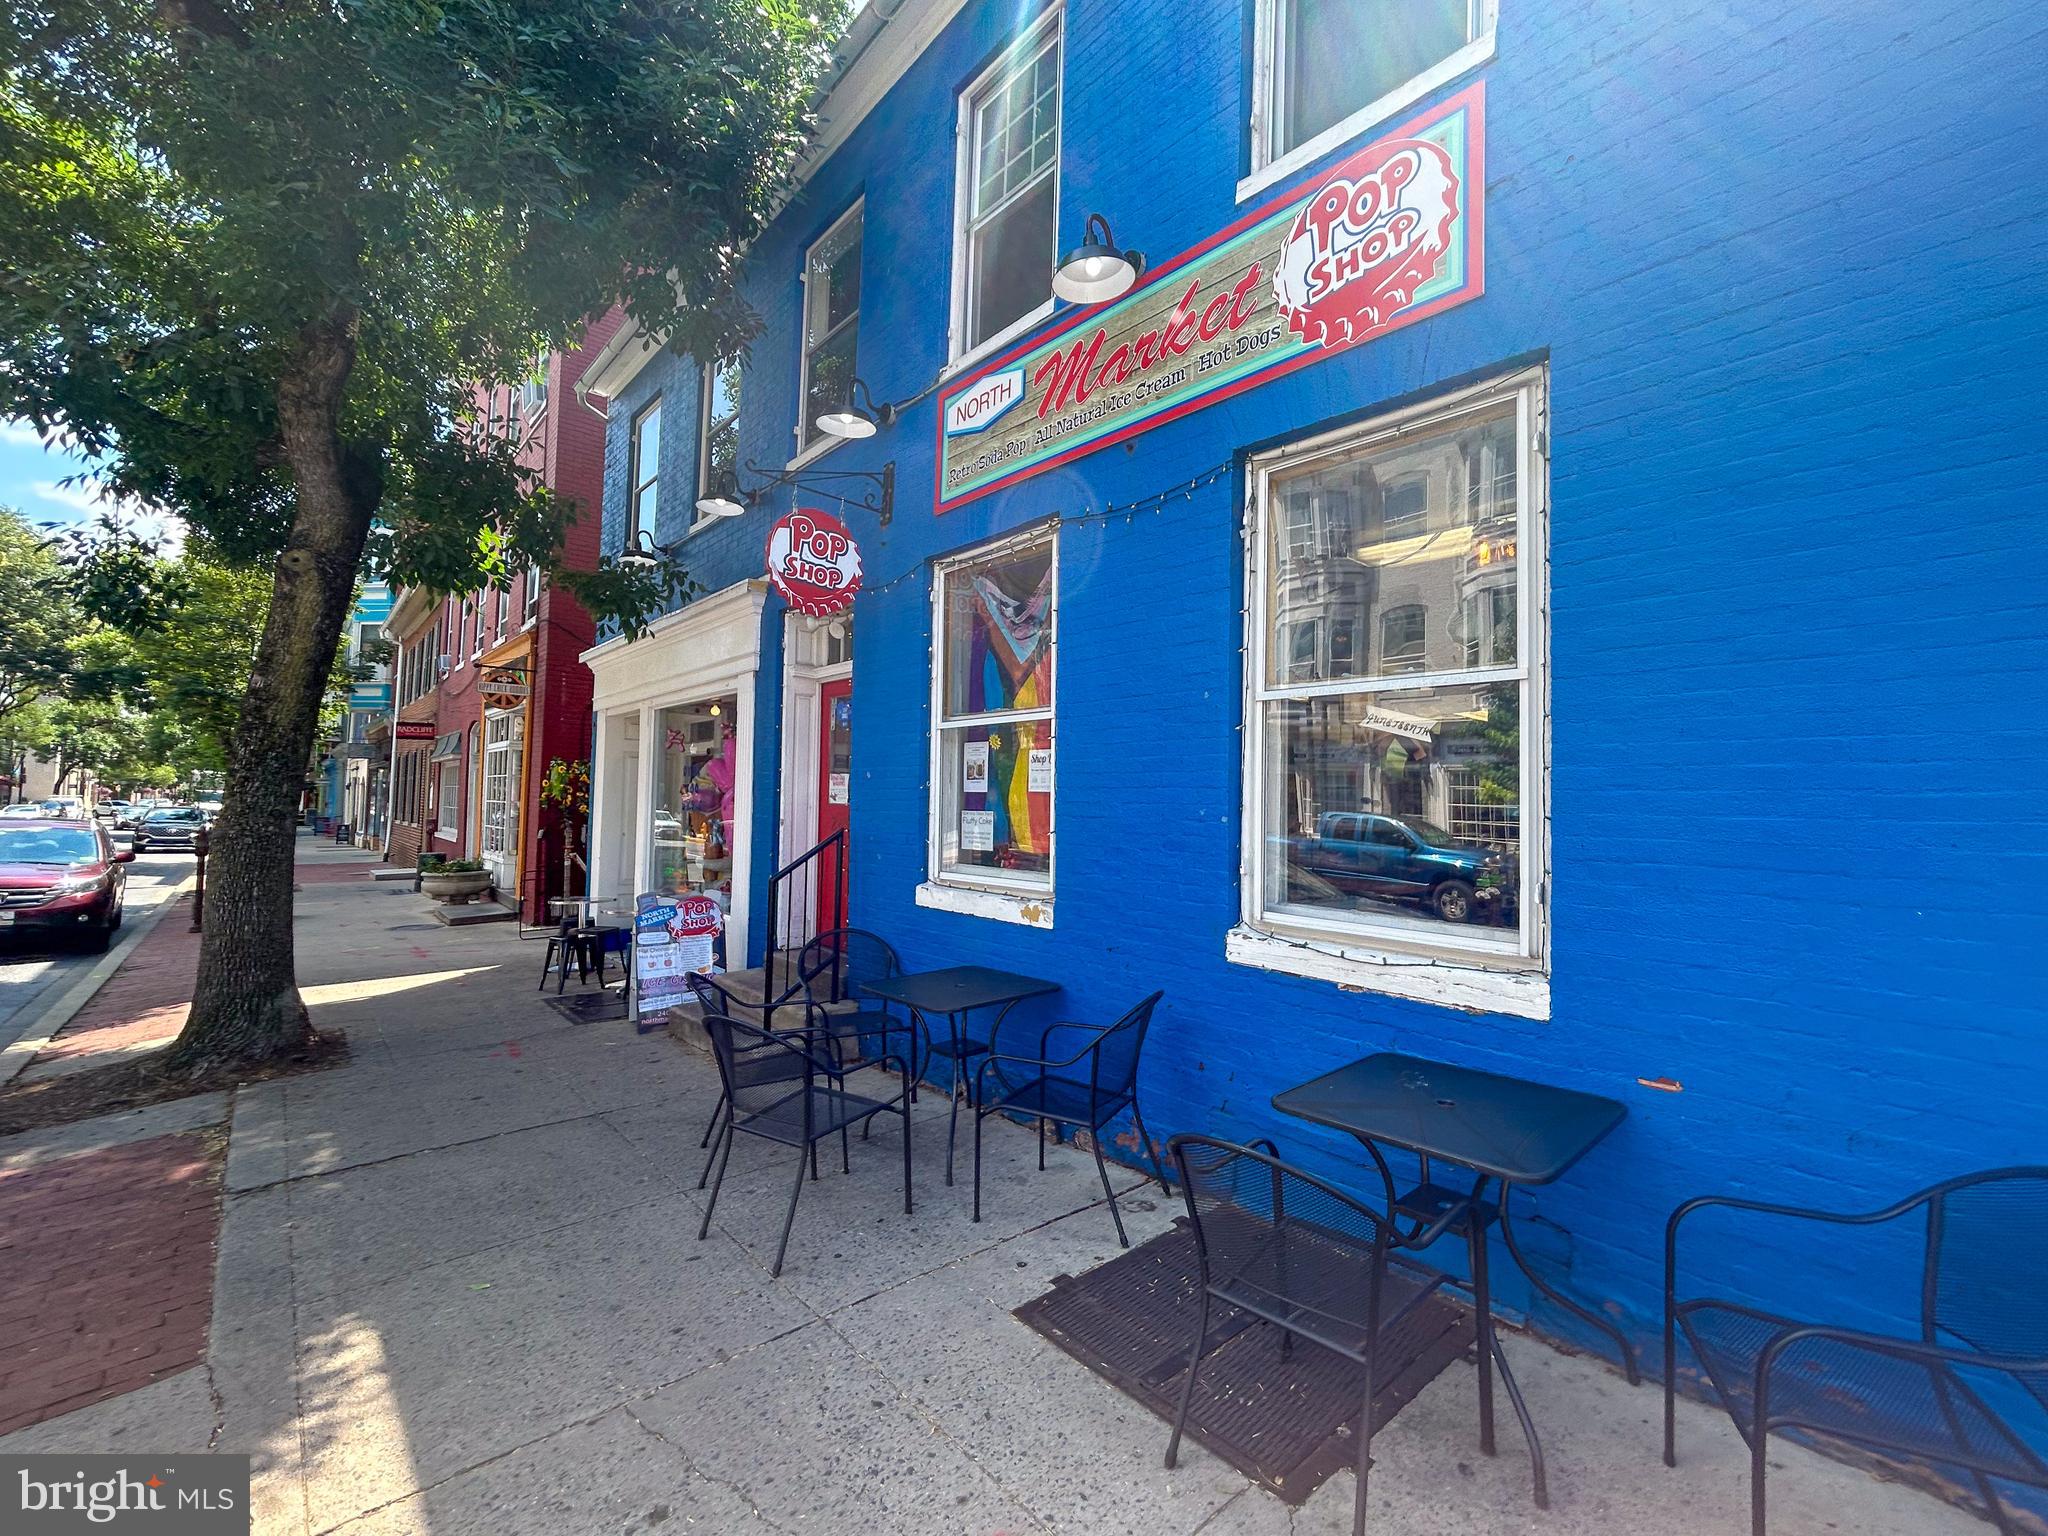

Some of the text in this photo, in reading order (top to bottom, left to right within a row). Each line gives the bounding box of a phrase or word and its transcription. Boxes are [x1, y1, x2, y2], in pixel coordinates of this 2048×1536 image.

[1308, 152, 1417, 255] POP
[1308, 211, 1417, 300] SHOP
[1033, 261, 1263, 419] Market
[949, 323, 1281, 483] Retro Soda Pop All Natural Ice Cream Hot Dogs
[956, 379, 1012, 425] NORTH
[790, 515, 847, 562] POP
[785, 555, 843, 589] SHOP
[1031, 753, 1047, 766] Shop
[640, 911, 675, 927] MARKET
[641, 907, 671, 919] NORTH
[682, 900, 714, 917] POP
[682, 915, 715, 929] SHOP
